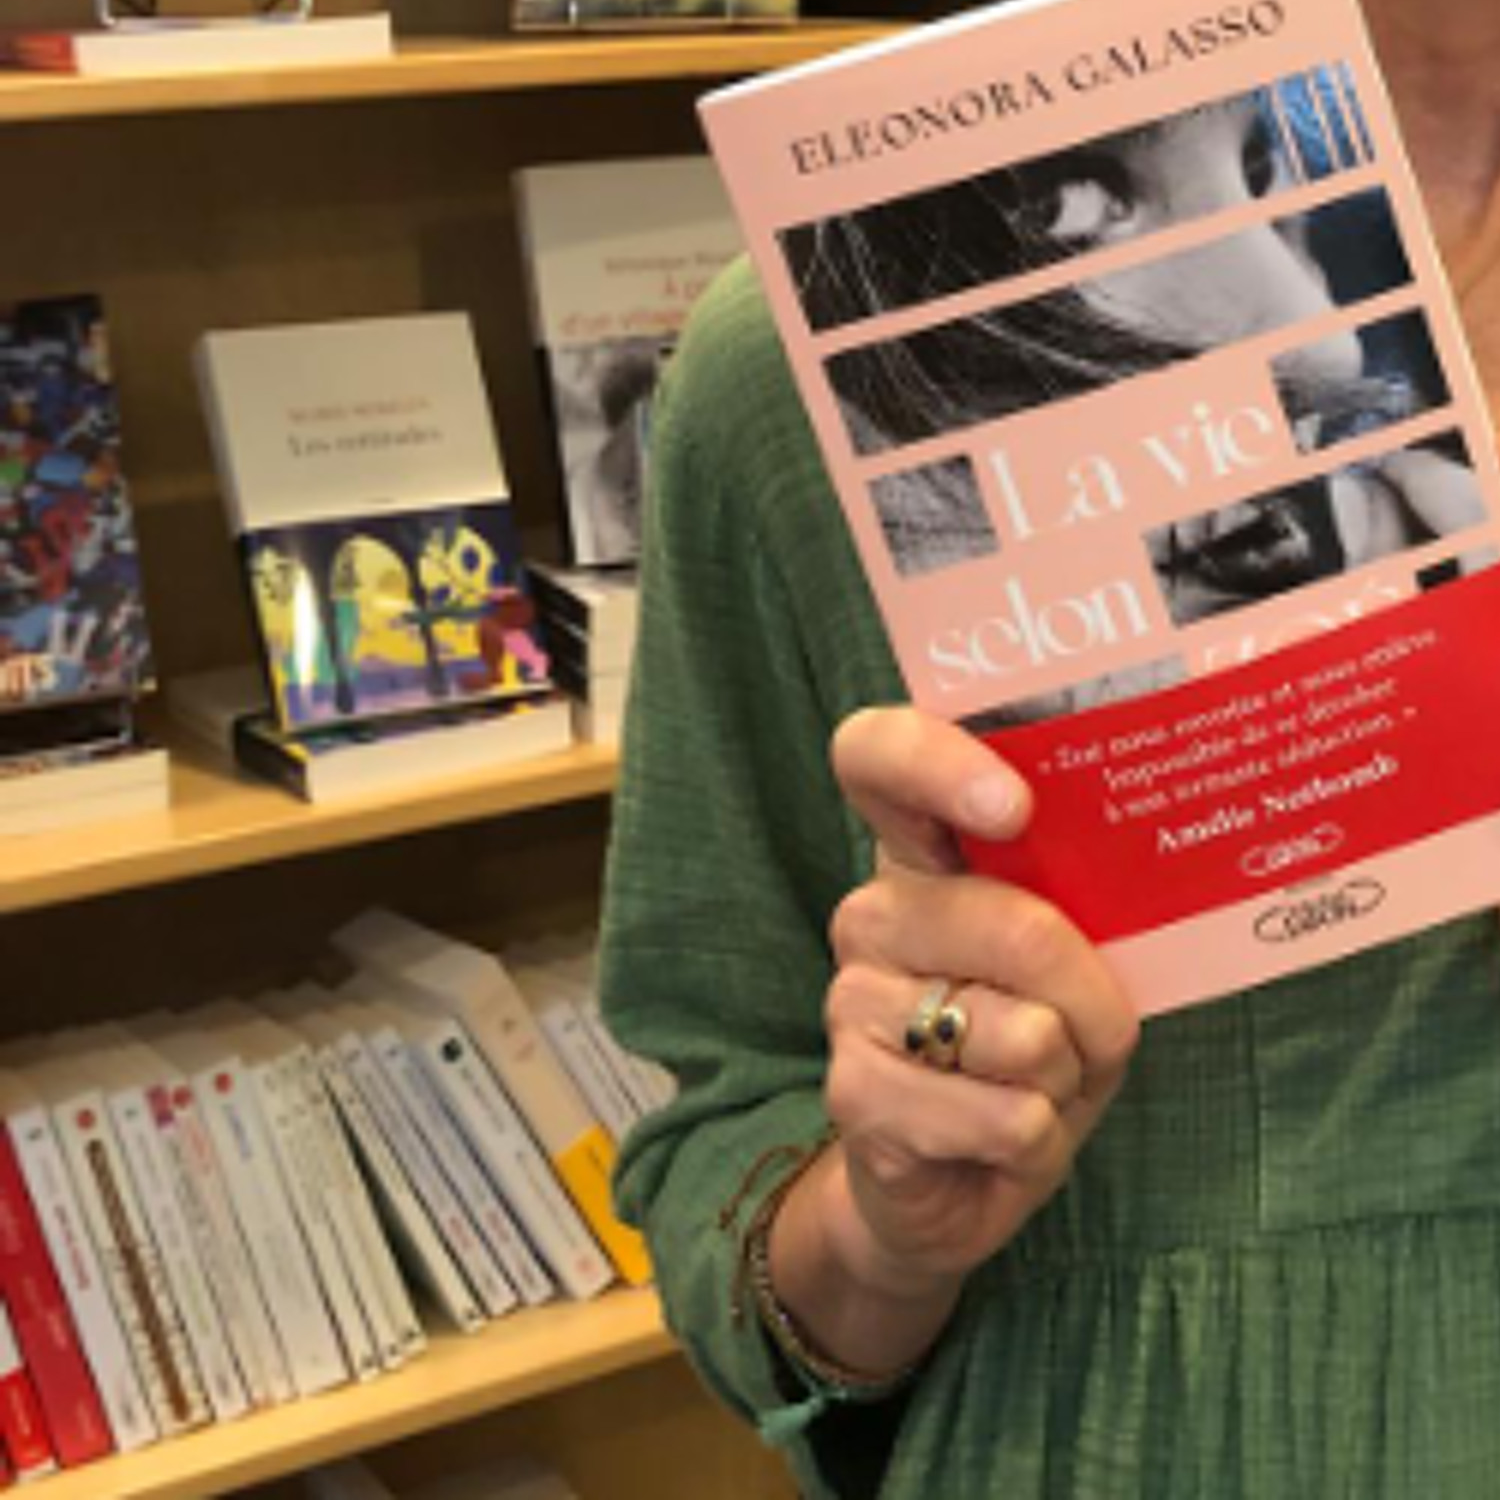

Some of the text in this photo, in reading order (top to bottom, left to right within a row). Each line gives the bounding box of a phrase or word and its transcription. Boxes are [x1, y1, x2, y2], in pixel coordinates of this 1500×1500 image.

[790, 71, 1053, 175] ELEONORA
[989, 402, 1274, 540] La vie
[927, 576, 1151, 693] selon
[1155, 800, 1256, 854] Amélie
[1262, 752, 1399, 816] Nothomb
